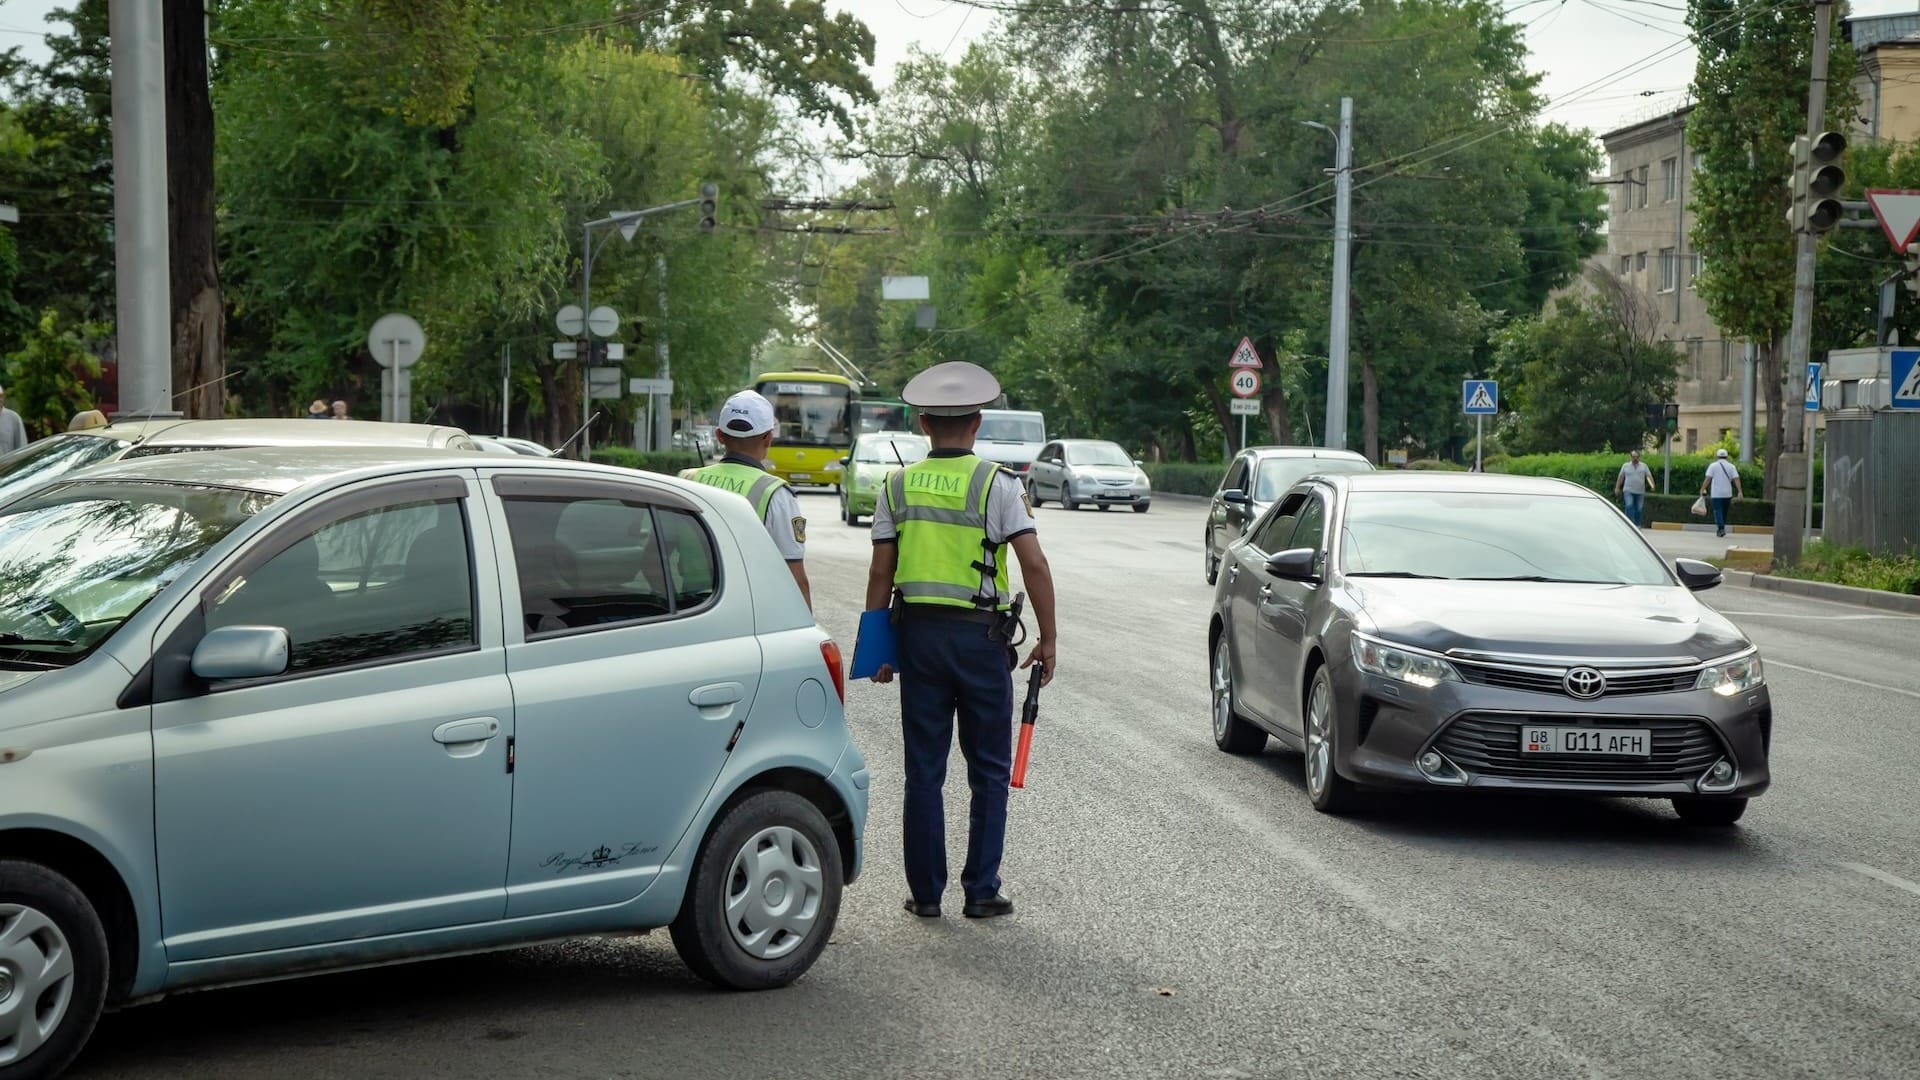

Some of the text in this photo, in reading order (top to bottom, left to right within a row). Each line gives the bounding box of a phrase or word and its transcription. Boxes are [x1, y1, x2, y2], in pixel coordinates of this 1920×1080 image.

[1236, 377, 1253, 388] 40
[910, 472, 960, 493] ИИМ
[1530, 730, 1642, 752] 08 011 AFH
